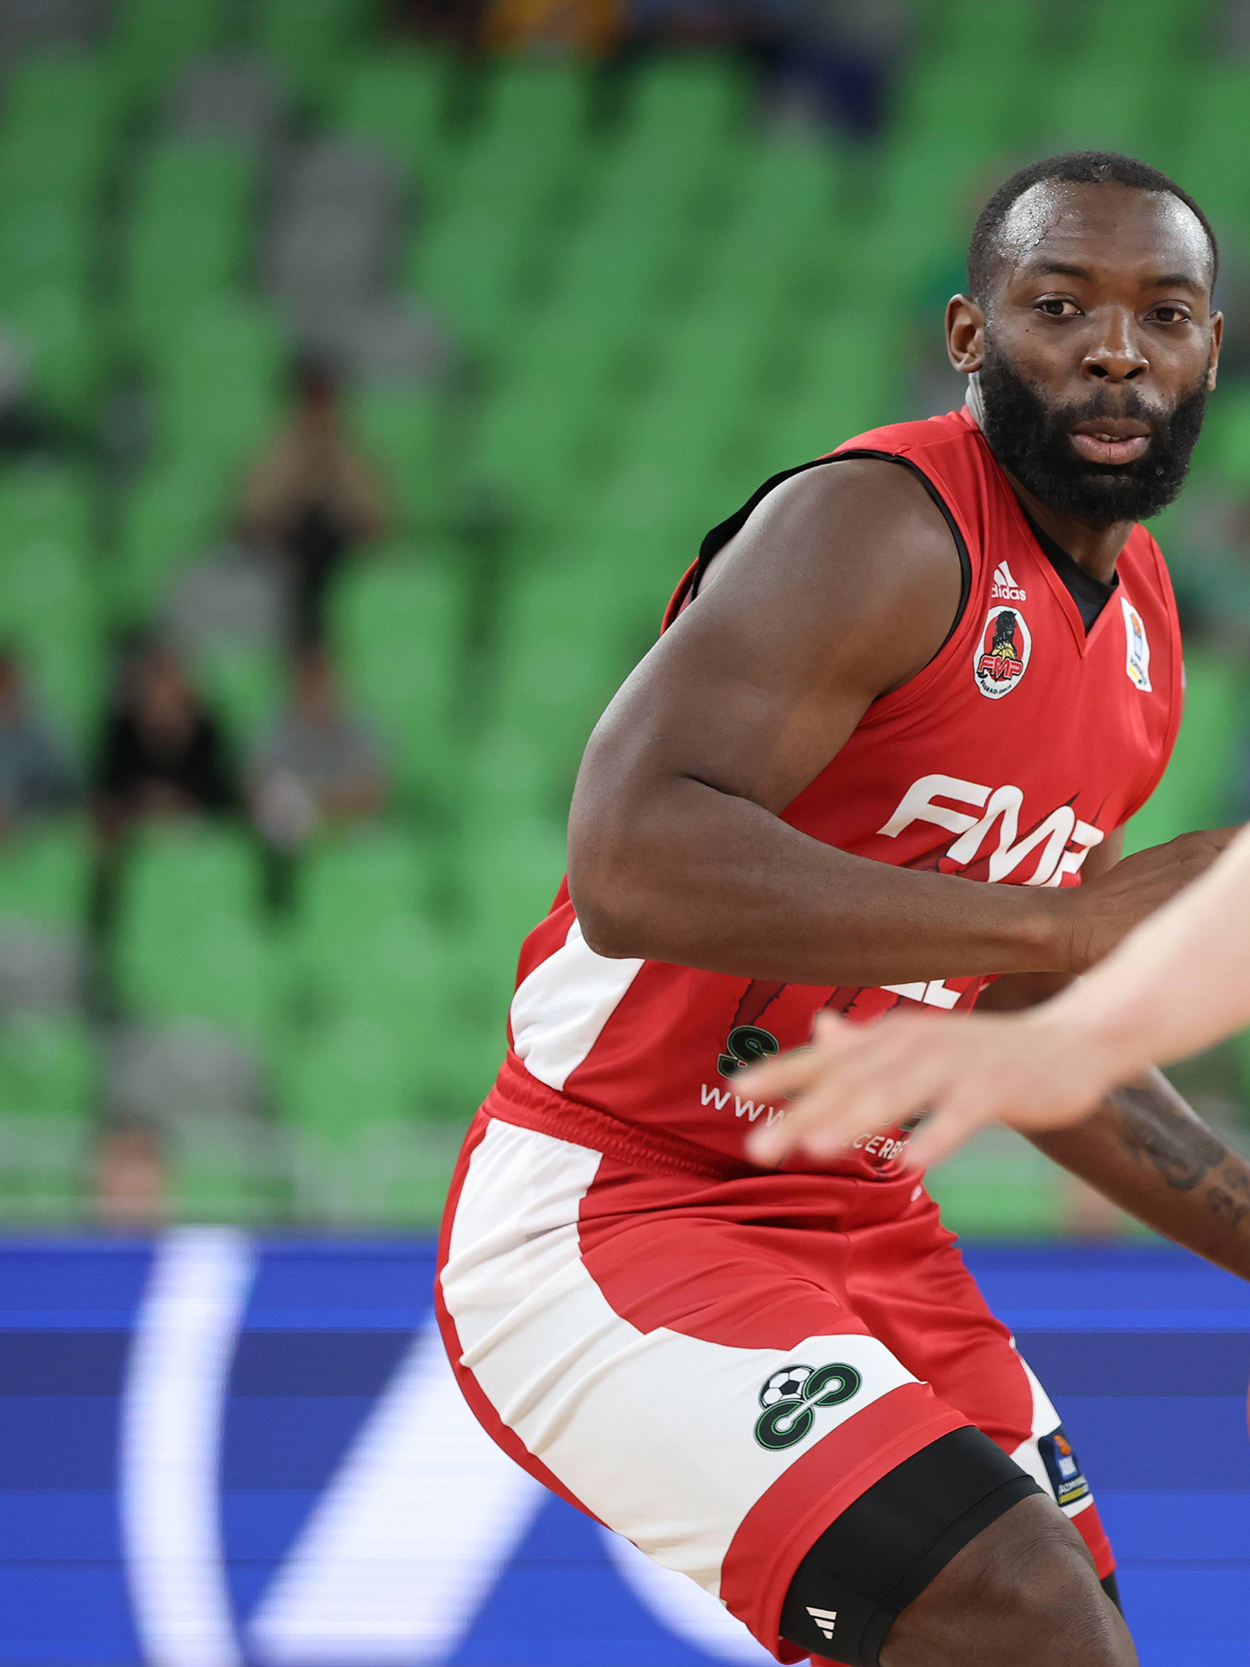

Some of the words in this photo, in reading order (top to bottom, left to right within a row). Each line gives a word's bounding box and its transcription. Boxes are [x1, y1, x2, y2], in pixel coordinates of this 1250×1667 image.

[991, 584, 1027, 601] didas
[977, 654, 1023, 681] FMP
[876, 774, 1104, 887] FMP
